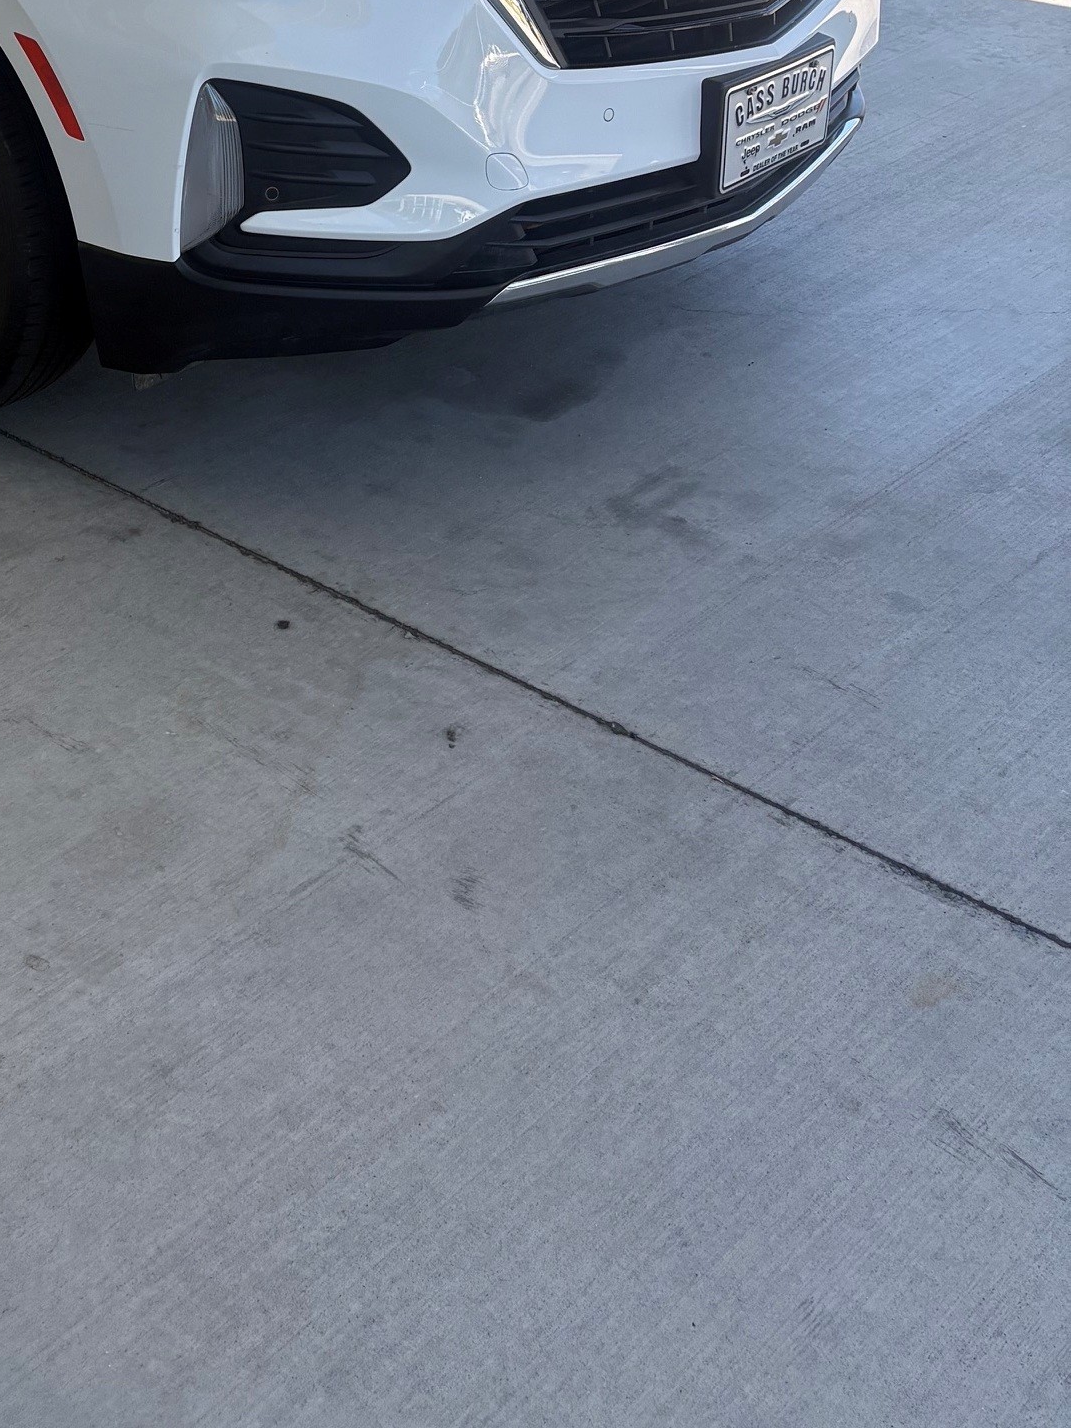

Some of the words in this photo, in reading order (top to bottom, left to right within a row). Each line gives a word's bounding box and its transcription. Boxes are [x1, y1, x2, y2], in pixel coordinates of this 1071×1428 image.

[735, 83, 775, 127] CASS
[781, 68, 827, 99] BURCH
[781, 104, 821, 127] DODGE
[795, 118, 816, 134] RAM
[735, 124, 775, 147] CHRYSLER
[741, 144, 761, 160] Jeep
[752, 157, 771, 172] DEALER
[770, 154, 778, 162] OF
[777, 151, 786, 159] THE
[786, 144, 799, 156] YEAR
